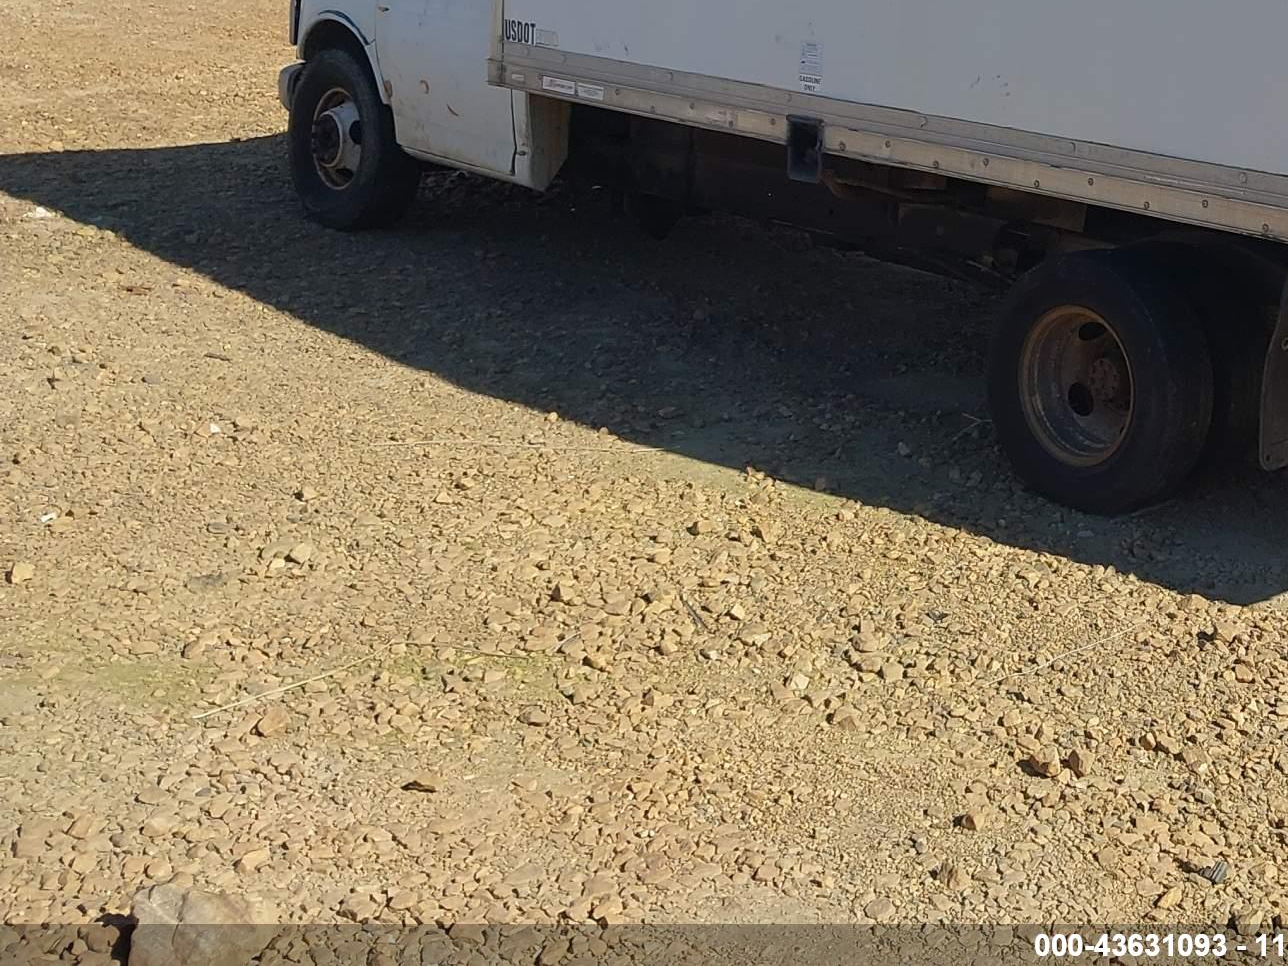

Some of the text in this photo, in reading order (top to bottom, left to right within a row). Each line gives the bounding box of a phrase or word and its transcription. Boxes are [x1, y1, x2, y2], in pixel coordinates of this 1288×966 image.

[504, 18, 537, 45] USDOT
[799, 75, 822, 85] GASOLINE
[803, 83, 817, 92] ONLY
